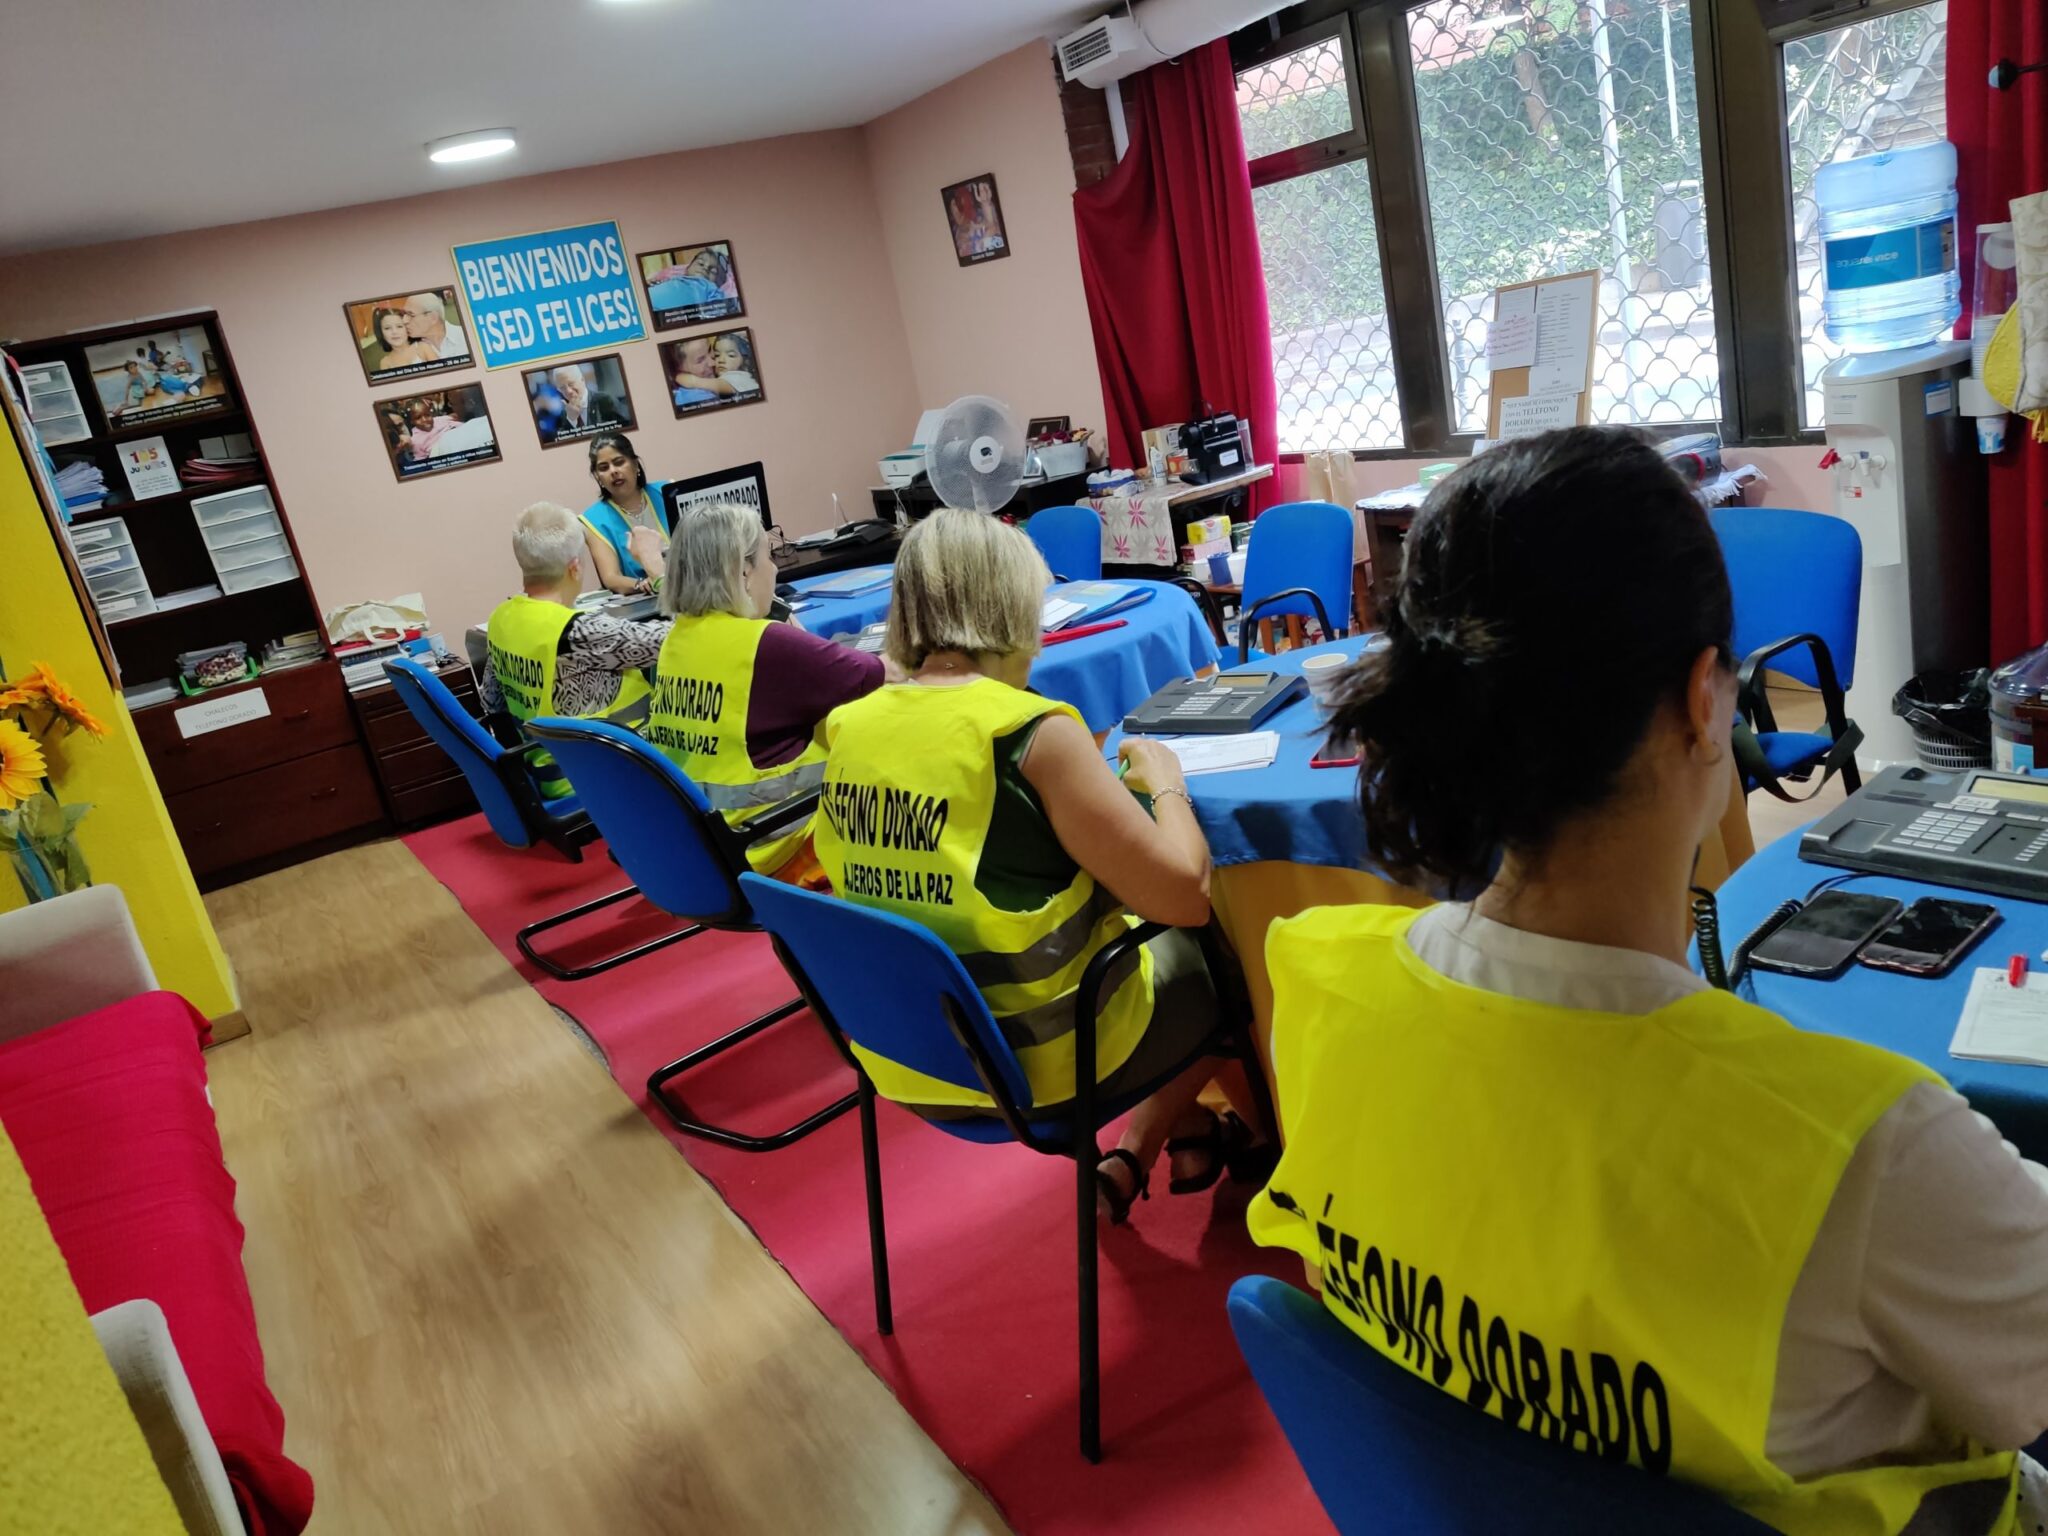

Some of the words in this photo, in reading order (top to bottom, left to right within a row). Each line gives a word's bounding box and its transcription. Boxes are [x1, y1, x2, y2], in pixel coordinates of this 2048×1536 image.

[462, 236, 624, 301] BIENVENIDOS
[478, 307, 535, 354] ¡SED
[536, 288, 638, 343] FELICES!
[675, 677, 723, 723] DORADO
[696, 735, 719, 756] PAZ
[886, 868, 902, 900] DE
[905, 871, 924, 902] LA
[927, 872, 953, 905] PAZ
[1458, 1294, 1673, 1476] DORADO
